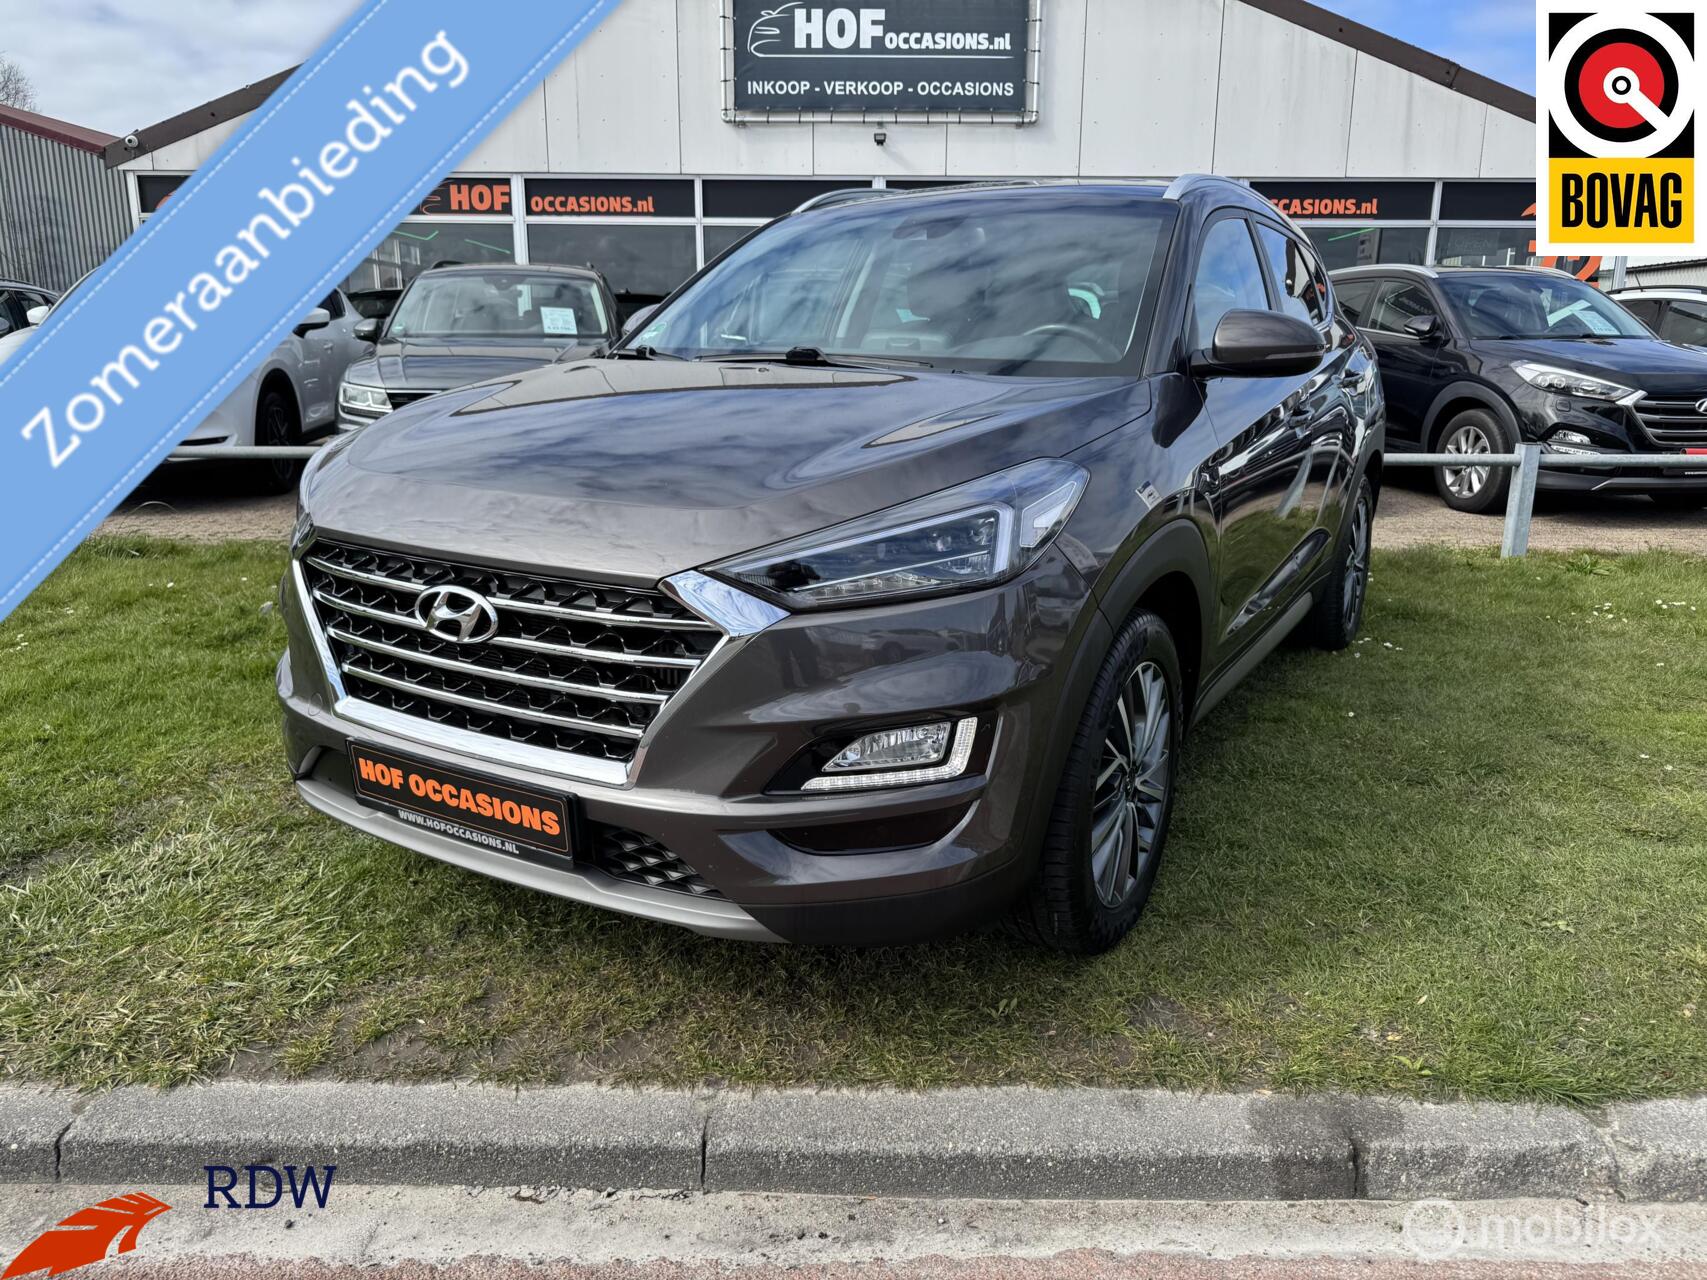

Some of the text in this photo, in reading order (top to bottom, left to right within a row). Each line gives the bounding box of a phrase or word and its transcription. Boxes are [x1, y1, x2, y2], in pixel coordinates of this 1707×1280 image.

[794, 8, 1011, 50] HOF OCCASIONS.nl
[748, 80, 810, 95] INKOOP
[824, 81, 903, 95] VERKOOP
[917, 82, 1014, 96] OCCASIONS
[450, 184, 654, 213] HOF OCCASIONS.nl
[358, 757, 561, 836] HOF OCCASIONS
[398, 810, 520, 854] WWW.HOFOCCASIONS.NL
